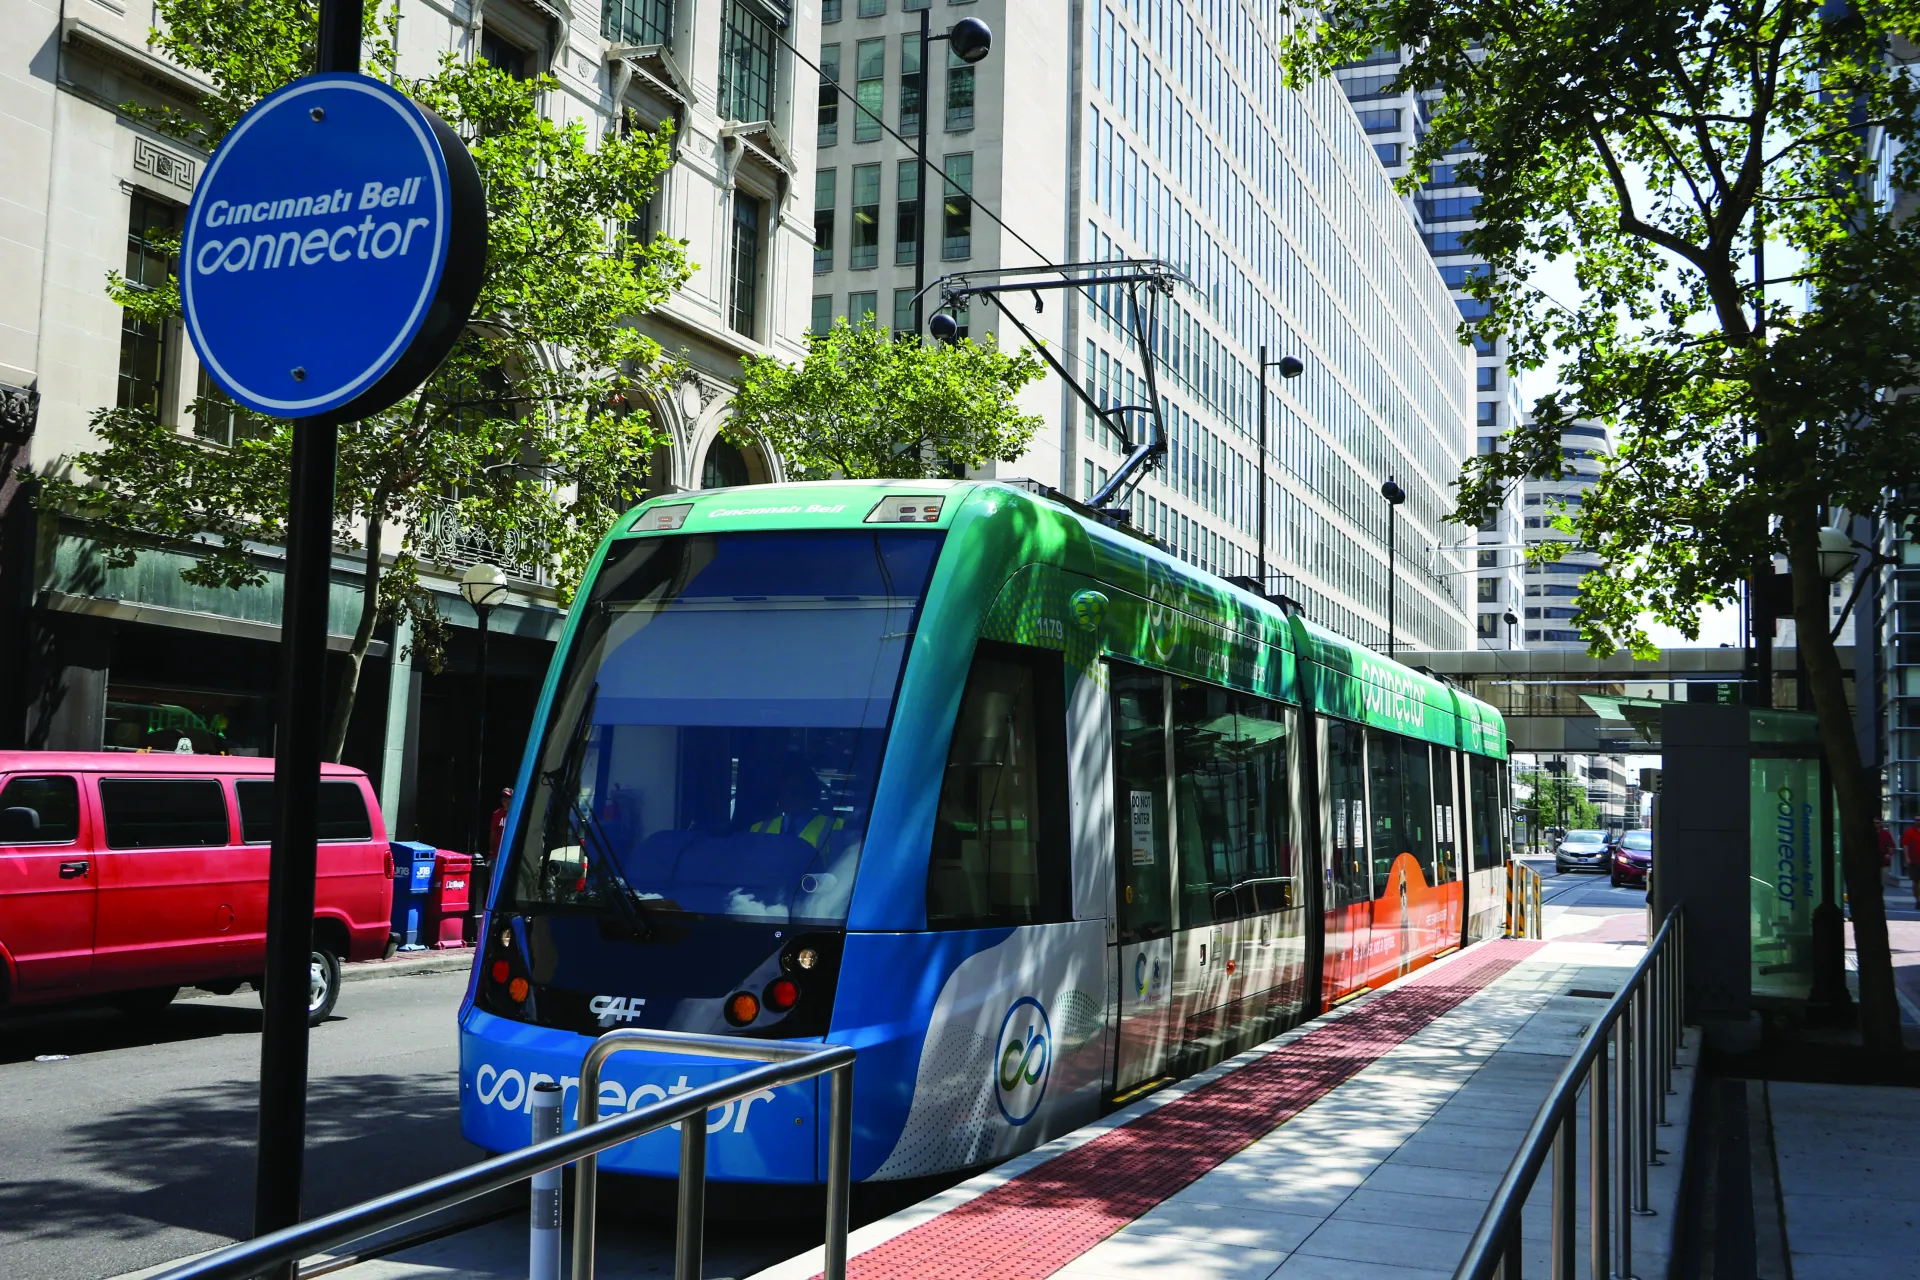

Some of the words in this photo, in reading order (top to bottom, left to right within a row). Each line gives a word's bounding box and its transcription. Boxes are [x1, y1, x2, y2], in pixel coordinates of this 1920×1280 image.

[205, 188, 353, 228] Cincinnati
[358, 176, 422, 210] Bell
[196, 213, 430, 275] connector
[708, 505, 802, 518] Cincinnati
[804, 504, 847, 514] Bell
[1037, 616, 1063, 640] 1179
[1361, 659, 1426, 728] connector
[1131, 795, 1139, 808] DO
[1140, 796, 1151, 809] NOT
[1133, 812, 1150, 825] ENTER
[1777, 786, 1798, 911] connector
[589, 995, 646, 1022] CAF
